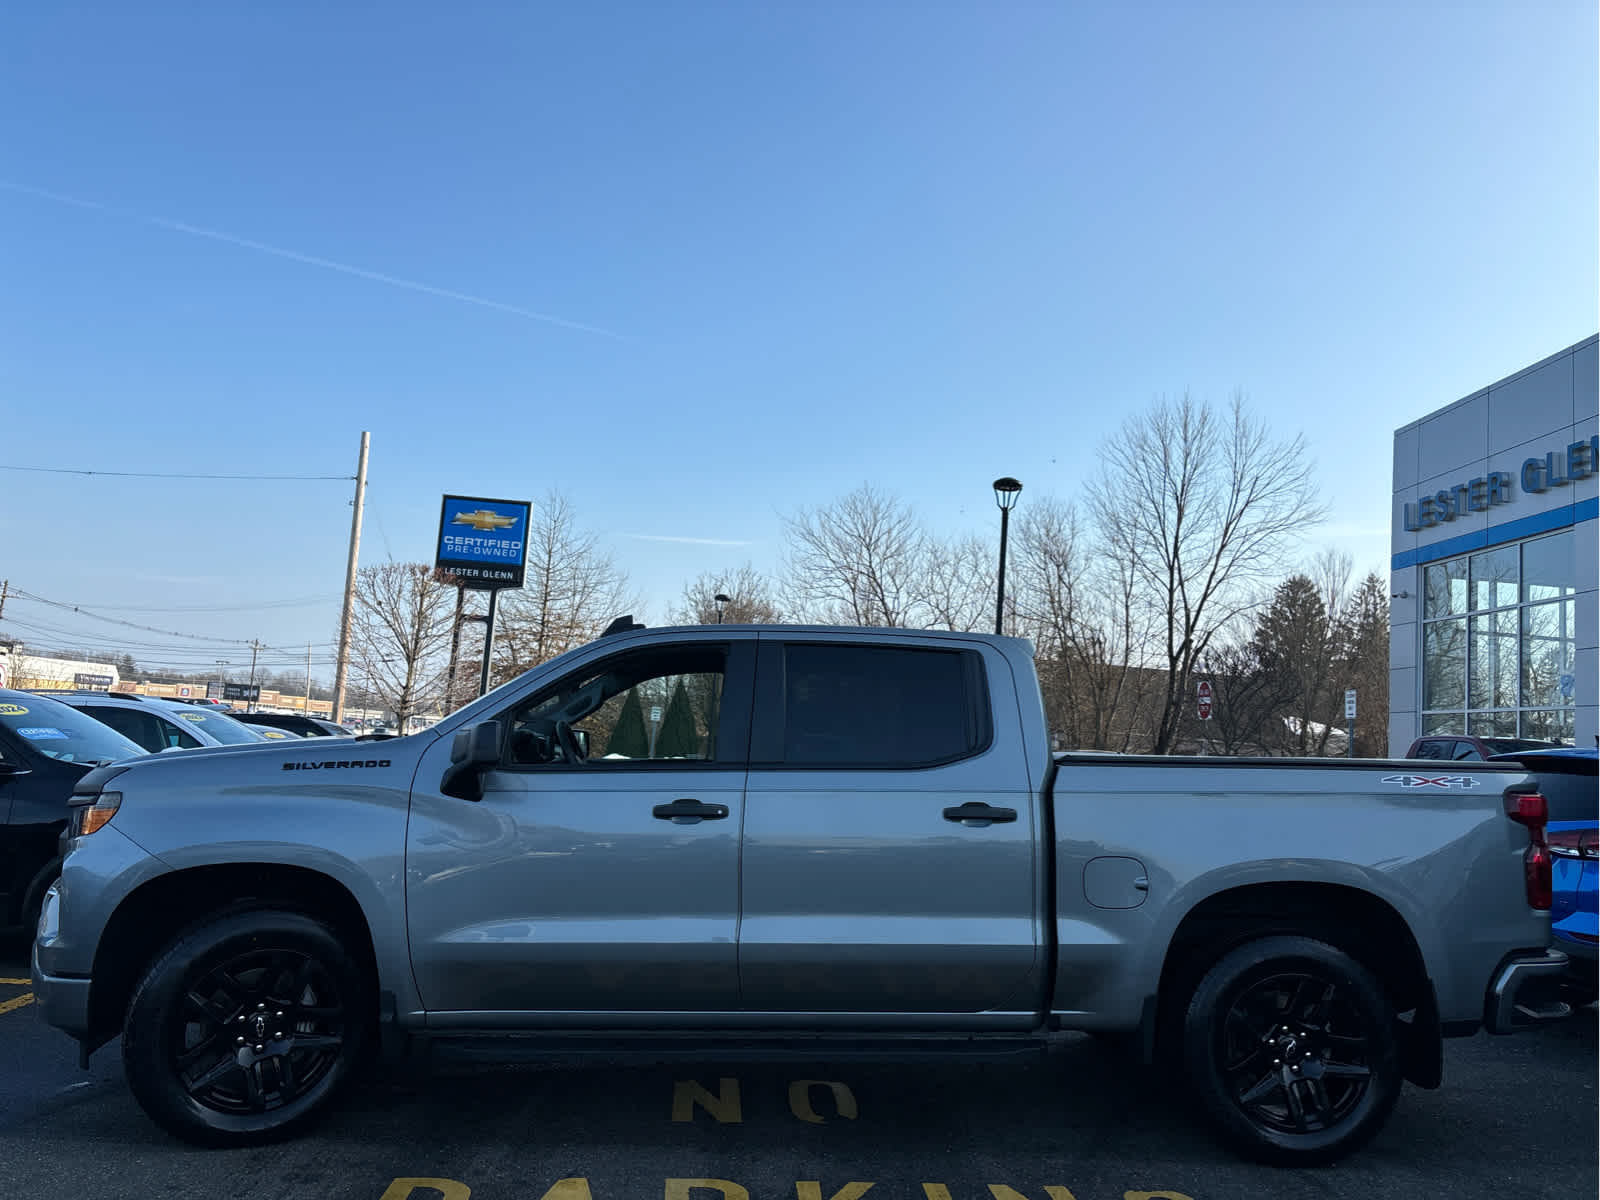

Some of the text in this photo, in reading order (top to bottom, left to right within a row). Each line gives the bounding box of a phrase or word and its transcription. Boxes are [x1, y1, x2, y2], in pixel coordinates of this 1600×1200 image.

[1404, 471, 1512, 531] LESTER
[444, 536, 520, 549] CERTIFIED
[447, 545, 516, 557] PRE-OWNED
[444, 567, 513, 579] LESTER GLENN
[281, 760, 392, 770] SILVERADO
[672, 1078, 858, 1123] NO
